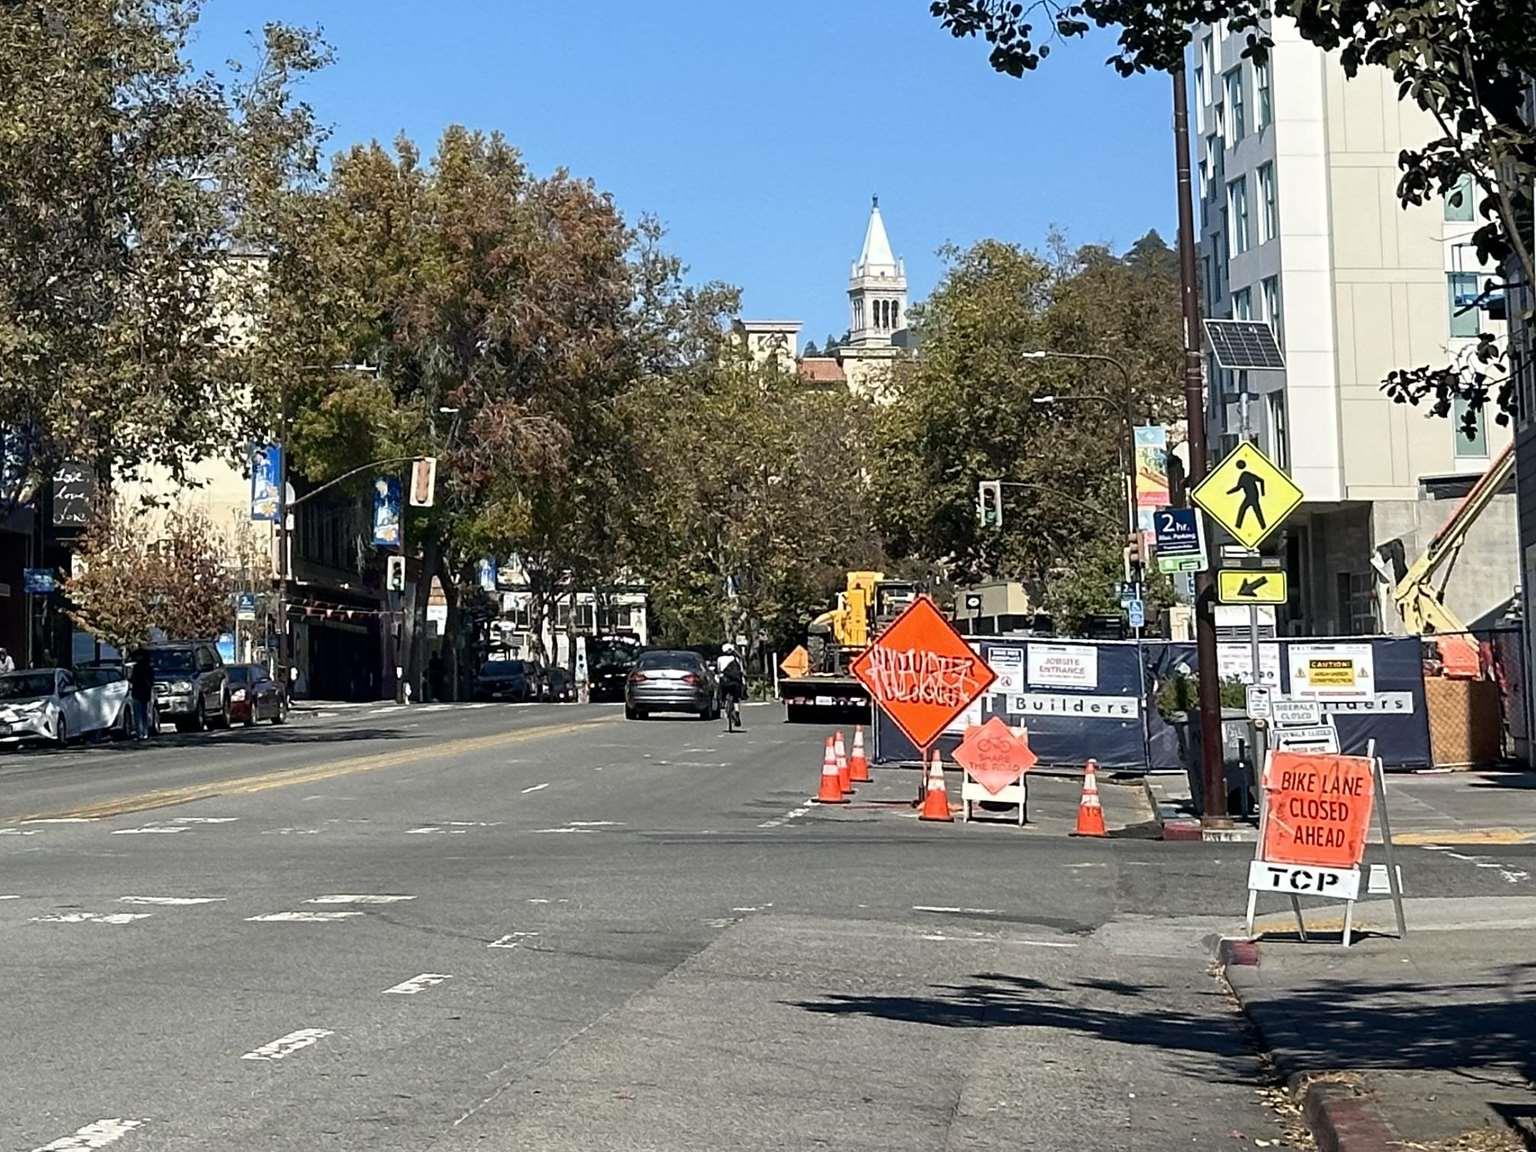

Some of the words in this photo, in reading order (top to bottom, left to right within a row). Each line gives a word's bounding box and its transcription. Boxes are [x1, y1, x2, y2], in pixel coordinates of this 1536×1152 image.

[1161, 513, 1175, 532] 2
[1039, 666, 1085, 675] ENTRANCE
[1016, 699, 1129, 714] Builders
[1275, 703, 1314, 711] SIDEWALK
[1280, 712, 1312, 720] CLOSED
[978, 753, 1010, 763] SHARE
[969, 762, 987, 771] THE
[992, 763, 1020, 772] ROAD
[1281, 771, 1316, 792] BIKE
[1323, 775, 1364, 796] LANE
[1289, 798, 1349, 821] CLOSED
[1293, 825, 1345, 847] AHEAD
[1268, 867, 1340, 891] TCP
